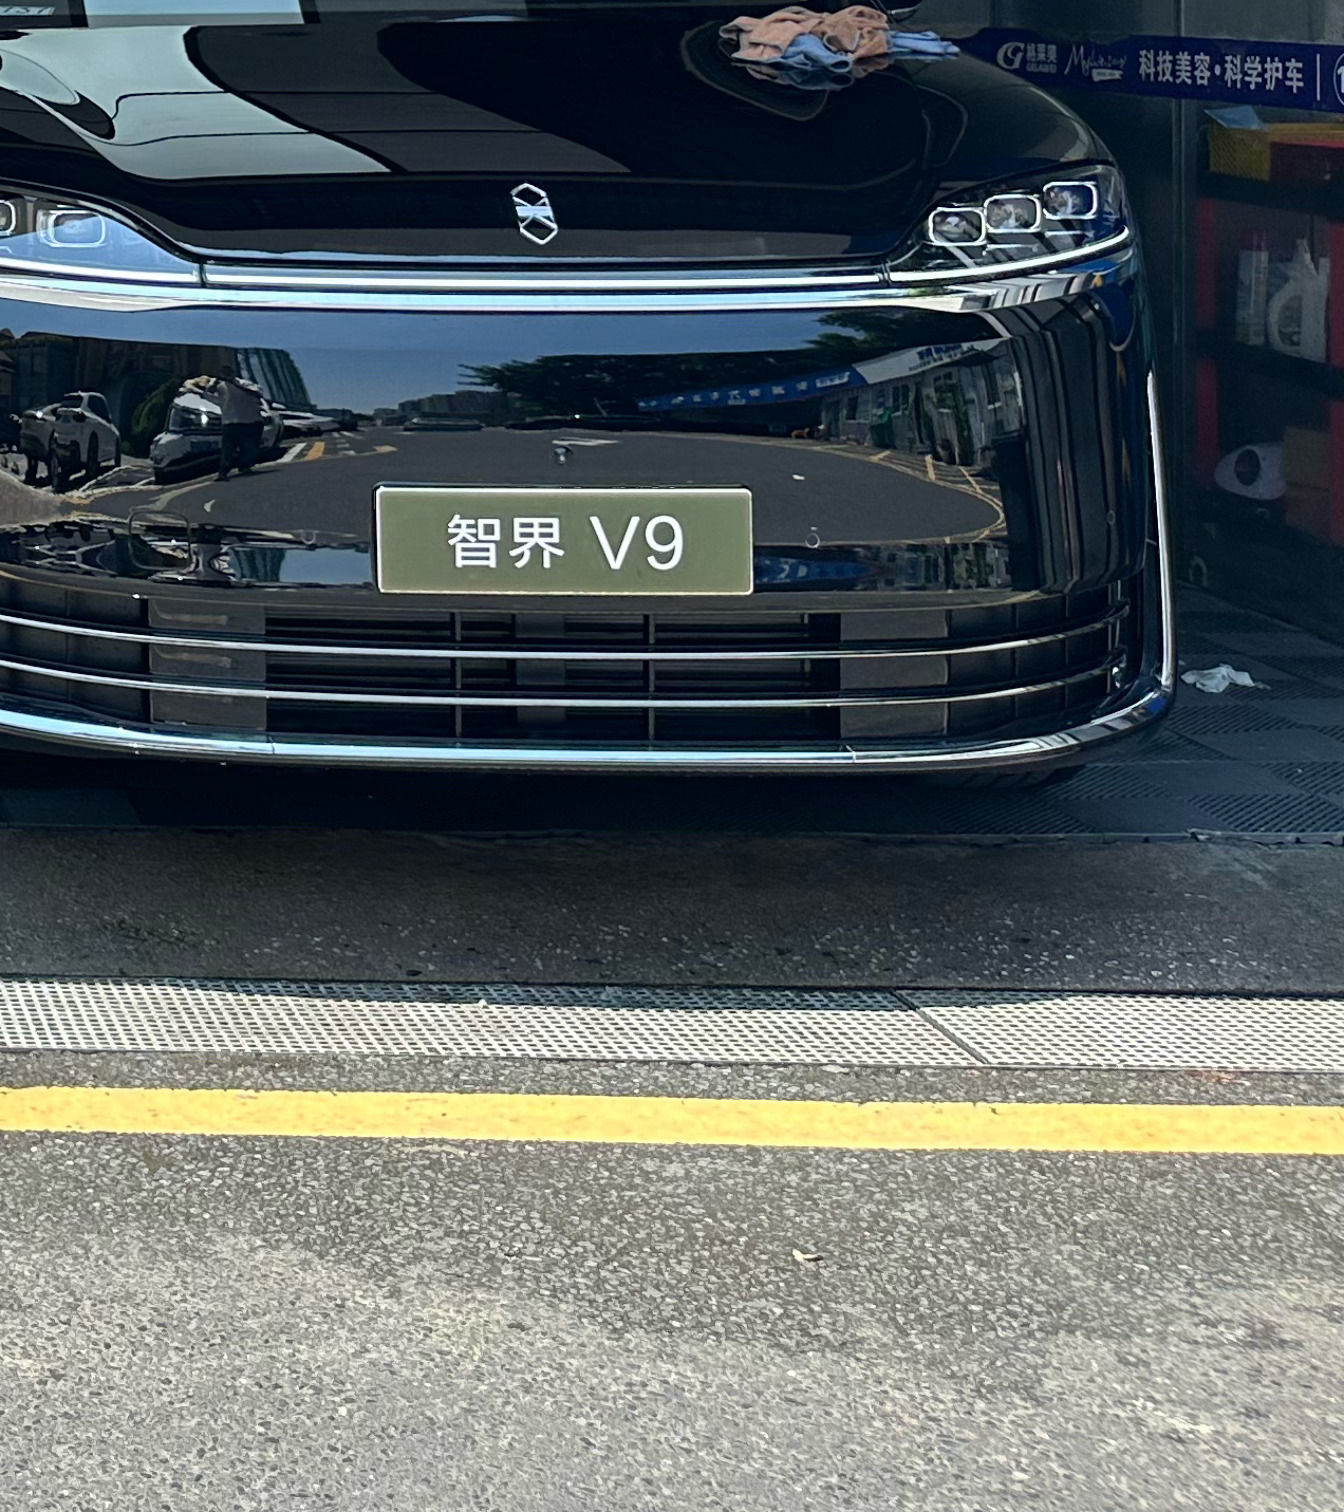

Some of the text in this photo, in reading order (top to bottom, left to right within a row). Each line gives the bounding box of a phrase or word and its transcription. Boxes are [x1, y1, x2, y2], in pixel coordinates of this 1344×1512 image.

[1138, 49, 1305, 94] 科技美容·科学护车
[447, 513, 685, 571] 智界 V9
